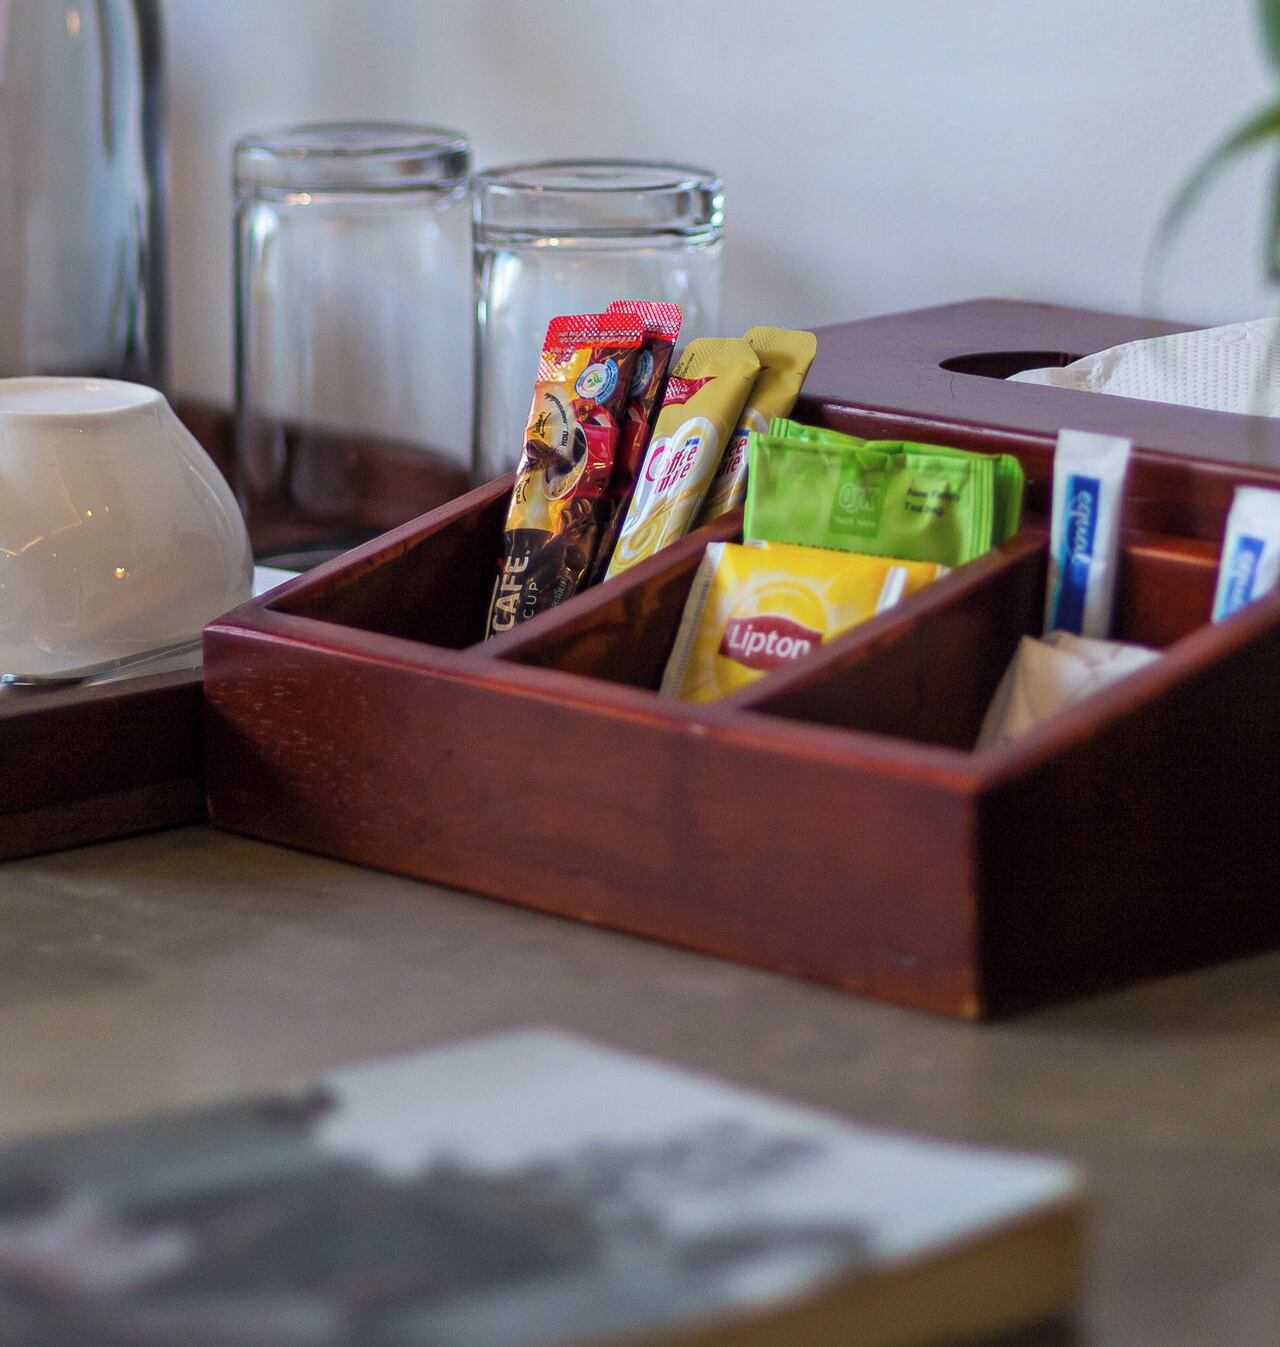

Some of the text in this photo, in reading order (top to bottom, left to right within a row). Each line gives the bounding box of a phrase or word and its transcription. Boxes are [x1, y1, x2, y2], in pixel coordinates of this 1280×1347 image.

[1070, 490, 1093, 565] equal
[523, 581, 539, 619] CUP
[728, 623, 810, 658] Lipton
